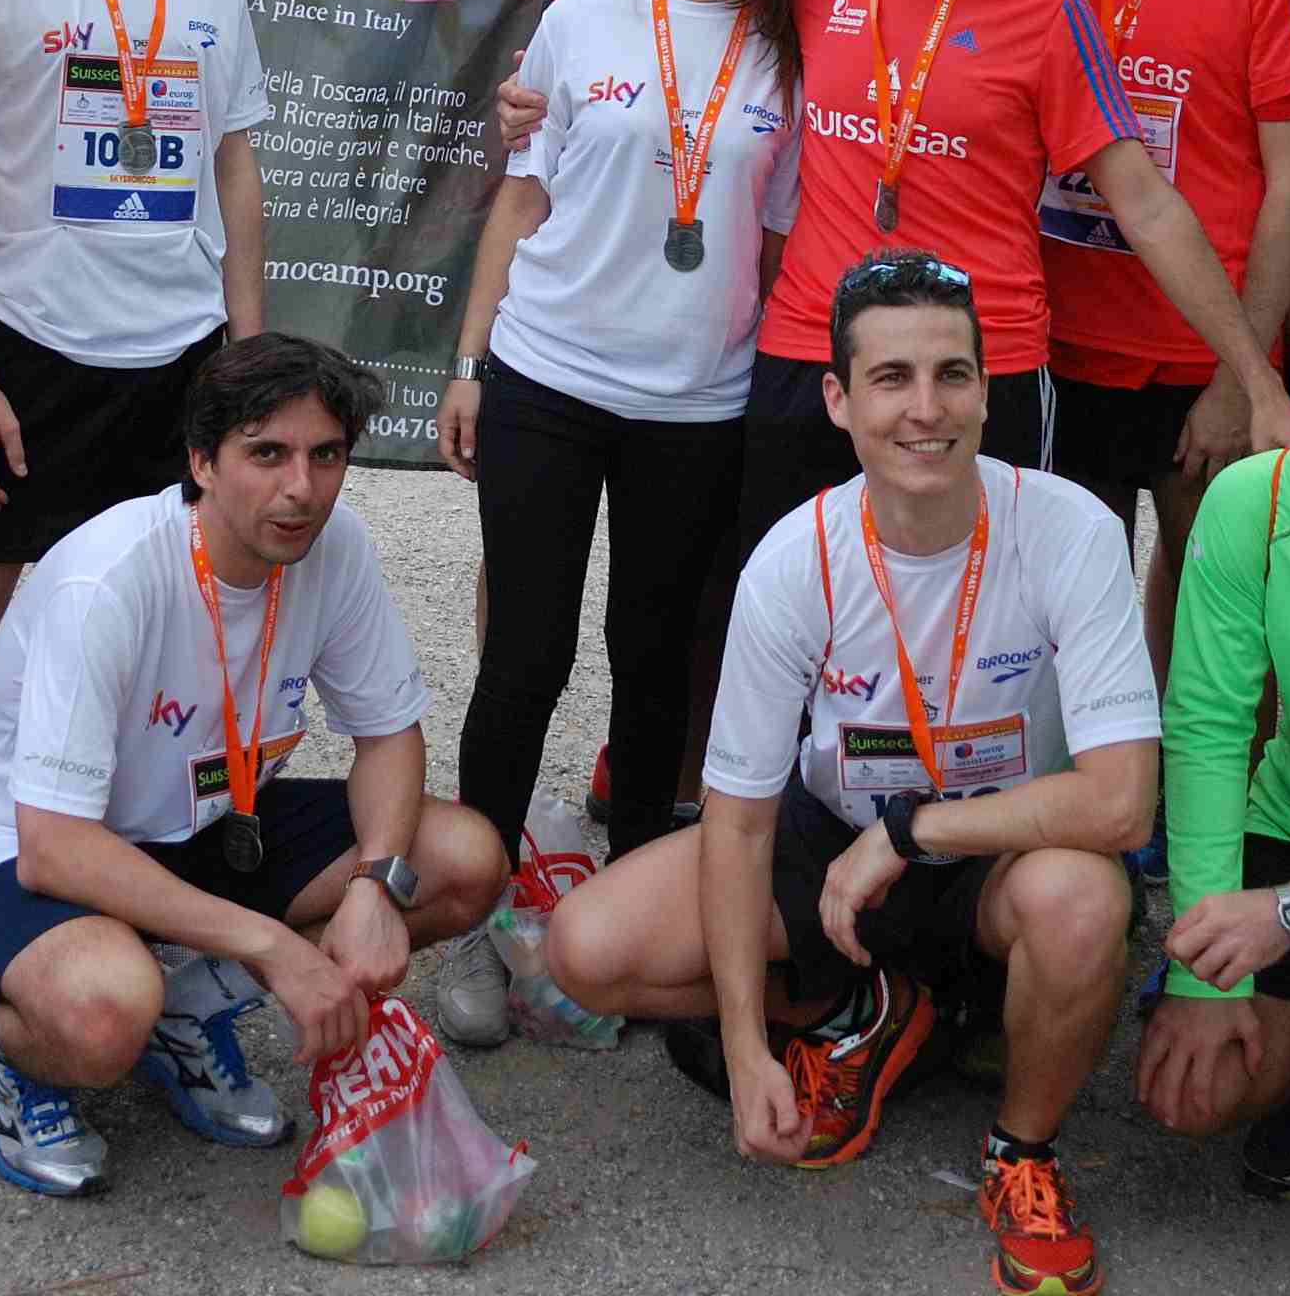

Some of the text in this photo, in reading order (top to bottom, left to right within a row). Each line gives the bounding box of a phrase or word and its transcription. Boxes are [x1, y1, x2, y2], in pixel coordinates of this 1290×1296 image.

[335, 4, 356, 26] in
[363, 9, 412, 38] Italy
[262, 68, 466, 108] della Toscana, il primo
[588, 75, 645, 108] sky
[283, 101, 378, 131] Ricreativa
[383, 109, 400, 130] in
[406, 109, 452, 137] Italia
[455, 119, 487, 142] per
[84, 131, 184, 170] 10B
[339, 137, 382, 163] gravi
[387, 141, 400, 158] e
[405, 142, 489, 171] croniche,
[260, 167, 428, 194] vera cura è ridere
[307, 195, 319, 218] è
[325, 196, 412, 227] l'allegria!
[264, 257, 449, 306] mocamp.org
[402, 385, 439, 409] tuo
[976, 646, 1043, 671] BROOKS
[821, 668, 882, 702] sky
[145, 688, 198, 737] ky
